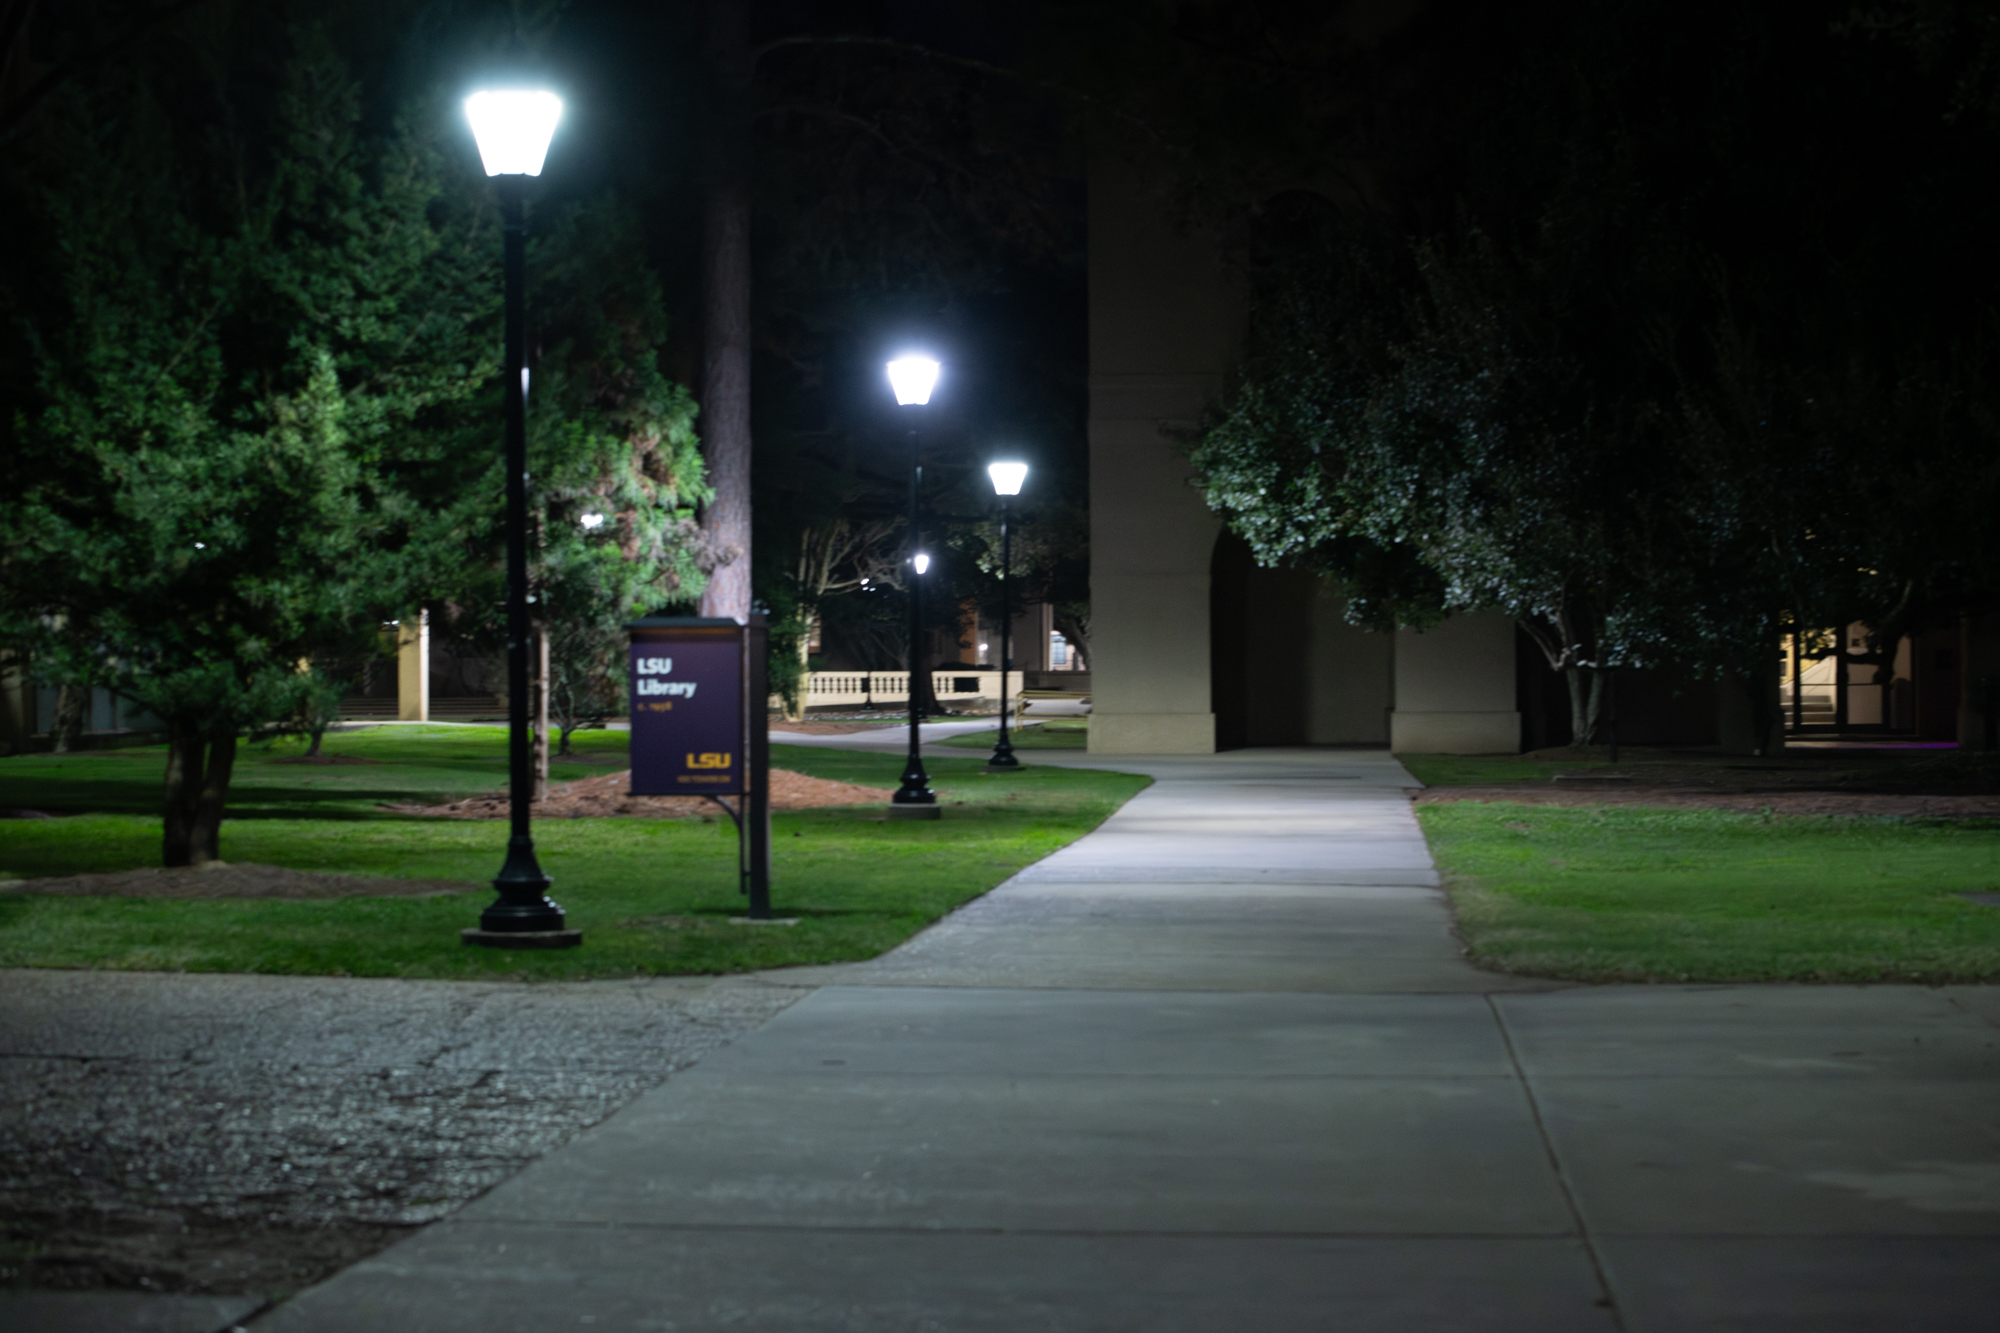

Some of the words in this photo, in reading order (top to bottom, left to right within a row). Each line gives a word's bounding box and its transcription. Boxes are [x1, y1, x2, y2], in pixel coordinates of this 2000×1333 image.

[637, 658, 672, 674] LSU
[637, 679, 697, 698] Library
[686, 753, 731, 769] LSU
